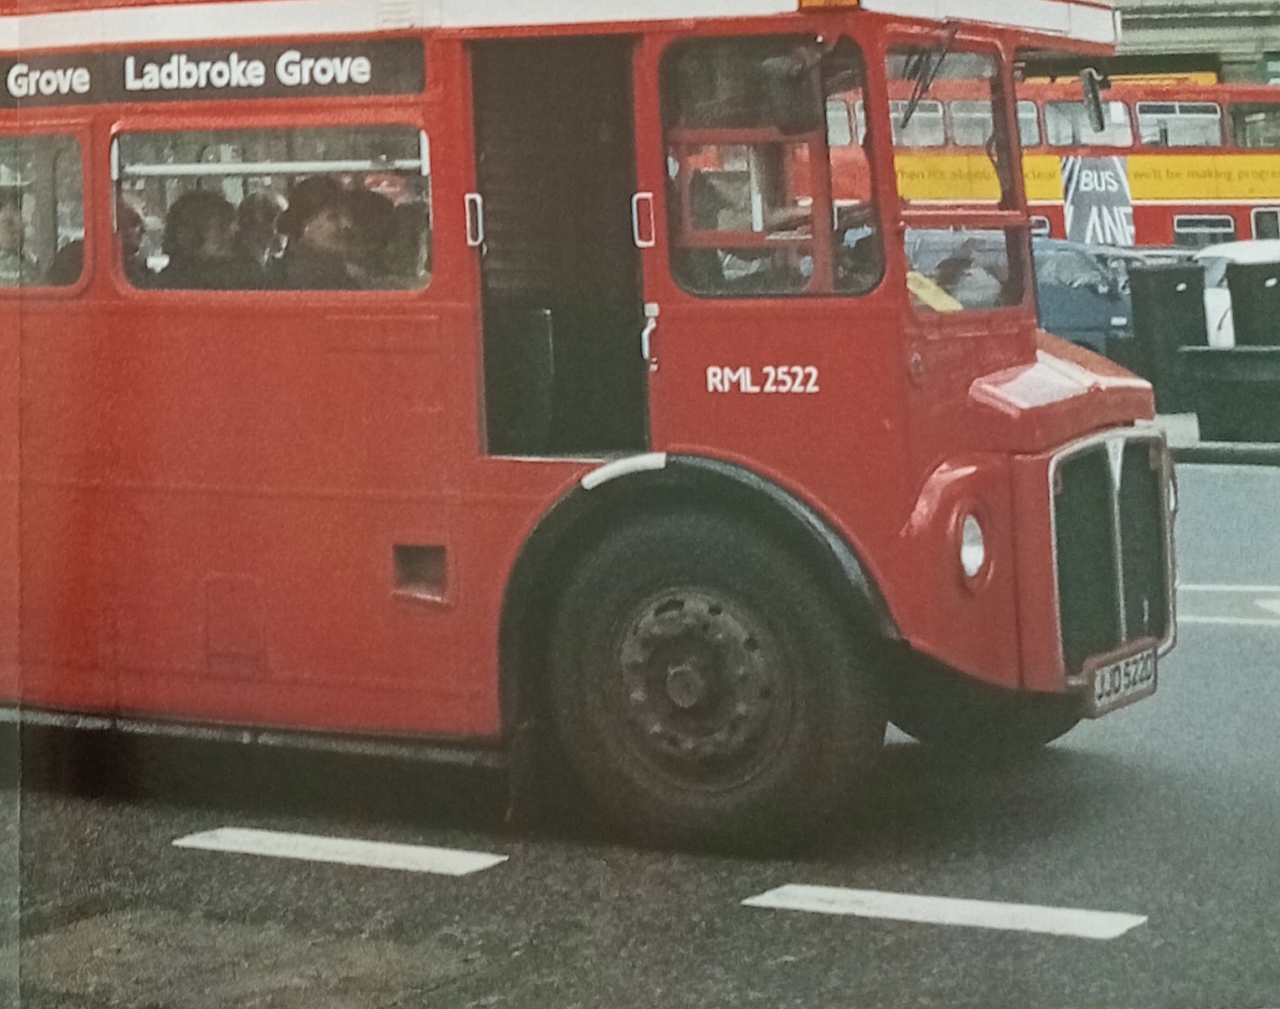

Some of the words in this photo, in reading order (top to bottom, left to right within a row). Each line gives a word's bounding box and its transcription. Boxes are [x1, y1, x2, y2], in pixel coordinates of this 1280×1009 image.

[6, 63, 91, 97] Grove
[123, 52, 267, 92] Ladbroke
[275, 49, 372, 87] Grove
[1078, 169, 1120, 193] BUS
[706, 365, 761, 393] RML
[762, 365, 820, 394] 2522
